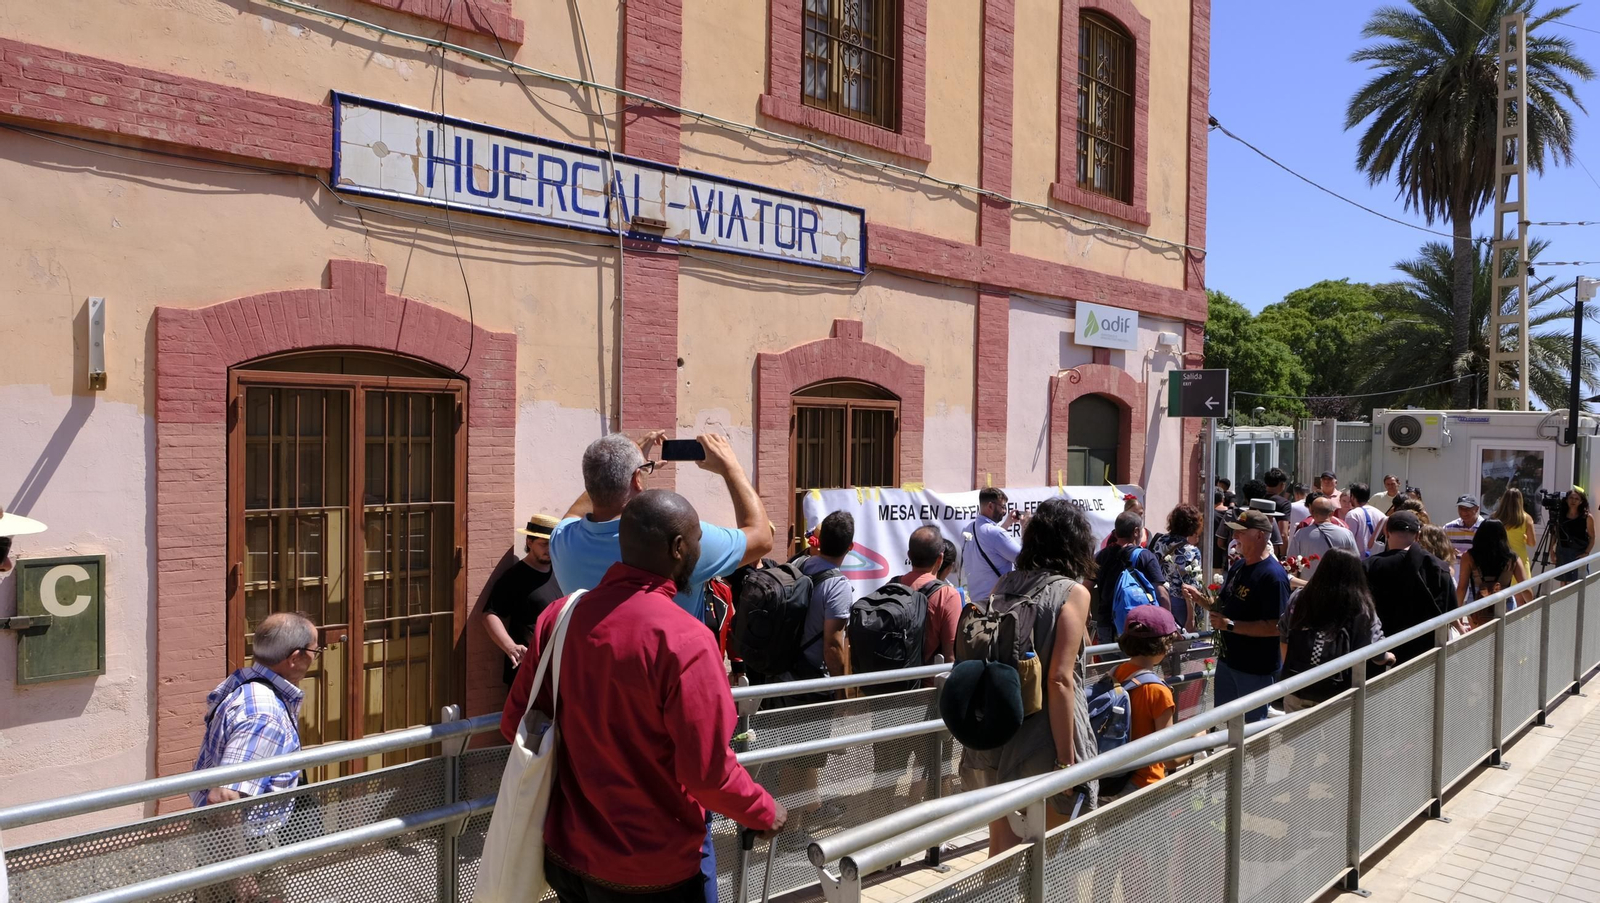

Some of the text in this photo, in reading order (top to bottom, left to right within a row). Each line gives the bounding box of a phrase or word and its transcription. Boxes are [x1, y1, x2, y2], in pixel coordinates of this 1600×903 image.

[1101, 315, 1131, 334] adif
[878, 504, 916, 521] MESA
[919, 504, 940, 520] EN
[1092, 498, 1106, 511] DE
[40, 564, 92, 617] C
